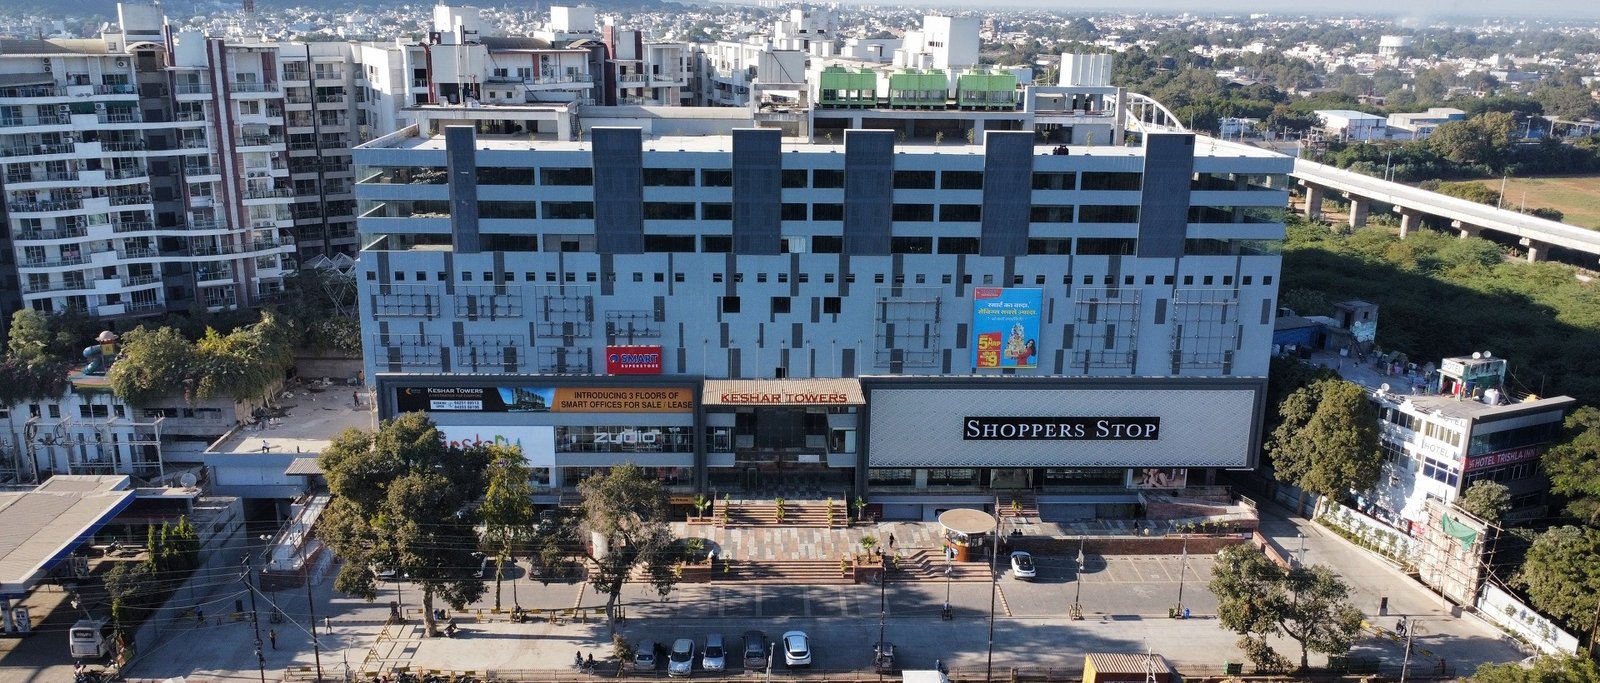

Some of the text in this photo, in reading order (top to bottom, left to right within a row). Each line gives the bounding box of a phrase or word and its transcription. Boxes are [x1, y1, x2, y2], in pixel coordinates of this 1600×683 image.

[621, 354, 658, 363] SMART
[574, 392, 627, 400] INTRODUCING
[720, 394, 848, 403] KESHAR TOWERS
[967, 420, 1156, 438] SHOPPERS STOP
[1424, 442, 1449, 458] HOTEL
[1475, 456, 1496, 468] HOTEL
[1497, 450, 1523, 464] TRISHLA
[1524, 448, 1536, 458] INN
